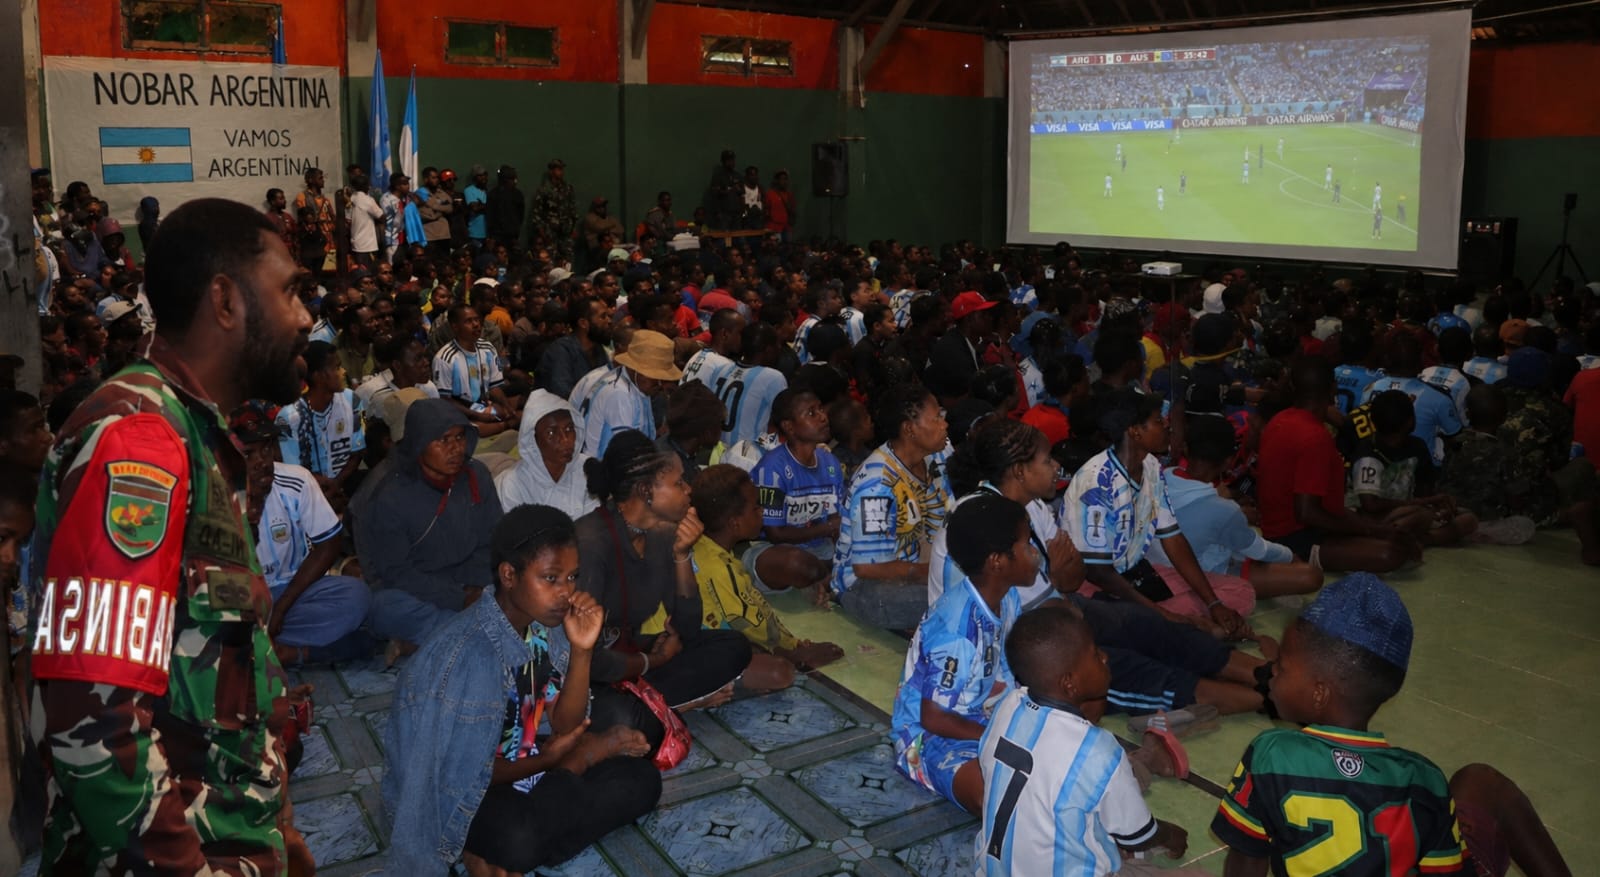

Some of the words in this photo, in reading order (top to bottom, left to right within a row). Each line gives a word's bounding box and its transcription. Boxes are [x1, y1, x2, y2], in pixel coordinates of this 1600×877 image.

[1072, 56, 1089, 65] ARG
[1130, 53, 1149, 62] AUS
[93, 71, 199, 106] NOBAR
[210, 74, 331, 109] ARGENTINA
[1046, 123, 1068, 133] VISA
[1078, 122, 1100, 132] VISA
[1111, 121, 1132, 131] VISA
[1143, 119, 1166, 129] VISA
[1266, 114, 1295, 125] QATAR
[1296, 112, 1336, 124] AIRWAYS
[223, 128, 292, 148] VAMOS
[987, 734, 1034, 861] 7
[1280, 789, 1421, 877] 21
